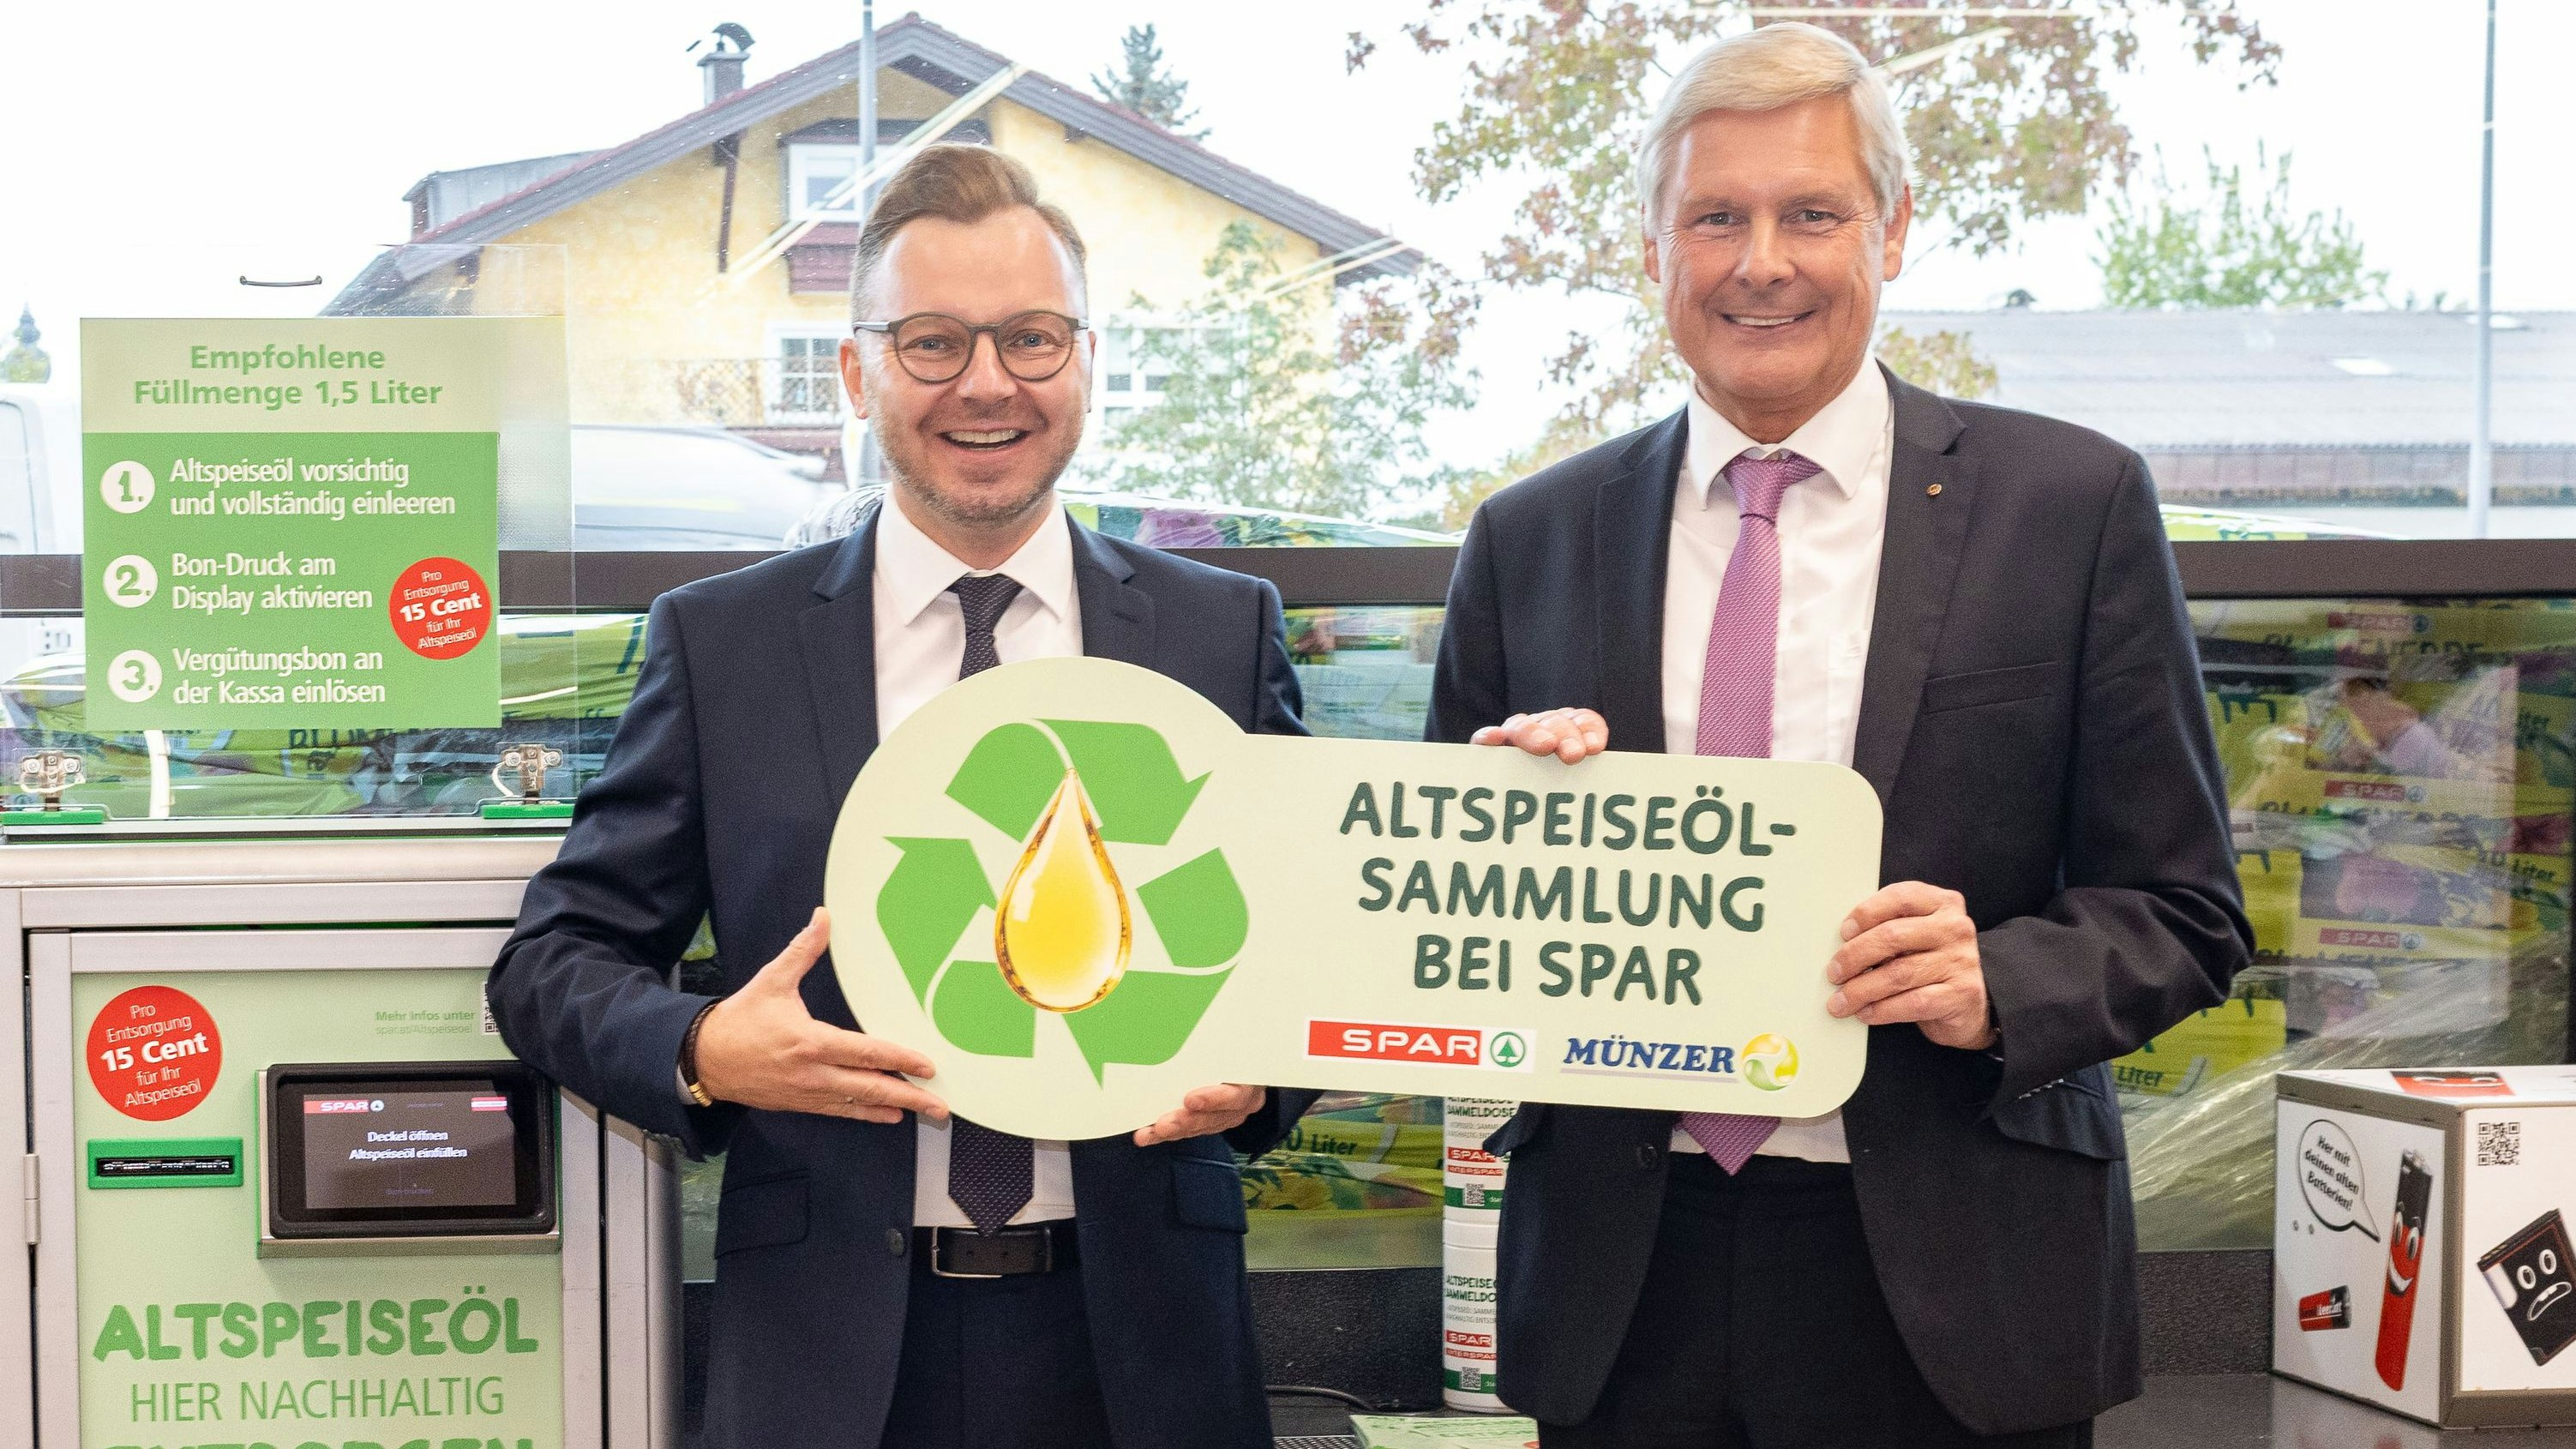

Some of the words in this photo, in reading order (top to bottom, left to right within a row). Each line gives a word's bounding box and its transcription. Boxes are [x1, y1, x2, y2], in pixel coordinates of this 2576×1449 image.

[190, 344, 385, 375] Empfohlene
[135, 379, 302, 410] Füllmenge
[315, 381, 358, 407] 1,5
[371, 380, 442, 404] Liter
[118, 471, 145, 502] 1.
[170, 457, 292, 487] Altspeiseöl
[300, 459, 409, 487] vorsichtig
[171, 490, 214, 514] und
[221, 490, 345, 520] vollständig
[352, 491, 455, 514] einleeren
[172, 551, 292, 576] Bon-Druck
[299, 557, 335, 576] am
[421, 571, 442, 583] Pro
[116, 565, 151, 597] 2.
[404, 580, 469, 600] Entsorgung
[171, 585, 255, 615] Display
[261, 585, 372, 608] aktivieren
[399, 603, 426, 622] 15
[430, 592, 483, 616] Cent
[418, 628, 477, 649] Altspeiseöl
[426, 620, 444, 633] für
[446, 617, 461, 629] Ihr
[123, 660, 154, 692] 3.
[172, 646, 346, 677] Vergütungsbon
[353, 651, 382, 670] an
[173, 680, 212, 704] der
[219, 682, 285, 704] Kassa
[291, 679, 385, 704] einlösen
[1340, 780, 1797, 857] ALTSPEISEÖL-
[1359, 858, 1766, 933] SAMMLUNG
[1414, 934, 1511, 993] BEI
[1538, 941, 1703, 1006] SPAR
[130, 1005, 156, 1019] Pro
[375, 1011, 407, 1020] Mehr
[444, 1011, 475, 1020] unter
[106, 1016, 192, 1043] Entsorgung
[100, 1047, 135, 1072] 15
[141, 1031, 209, 1063] Cent
[1342, 1028, 1478, 1060] SPAR
[1563, 1033, 1735, 1073] MÜNZER
[136, 1071, 158, 1085] für
[161, 1066, 181, 1081] Ihr
[124, 1078, 202, 1107] Altspeiseöl
[320, 1101, 370, 1112] SPAR
[367, 1130, 406, 1142] Deckel
[409, 1130, 448, 1141] öffnen
[1310, 1133, 1357, 1156] Liter
[2317, 1135, 2334, 1154] Her
[2334, 1150, 2351, 1167] mit
[349, 1147, 415, 1161] Altspeiseöl
[417, 1146, 467, 1158] einfüllen
[1450, 1150, 1496, 1162] SPAR
[2304, 1148, 2335, 1176] deinen
[2336, 1172, 2359, 1194] alten
[2307, 1170, 2353, 1212] Batterien!
[1445, 1290, 1497, 1302] SAMMELDO
[1446, 1275, 1497, 1289] ALTSPEISE
[93, 1285, 538, 1362] ALTSPEISEÖL
[1449, 1332, 1492, 1345] SPAR
[131, 1381, 220, 1422] HIER
[240, 1376, 505, 1419] NACHHALTIG
